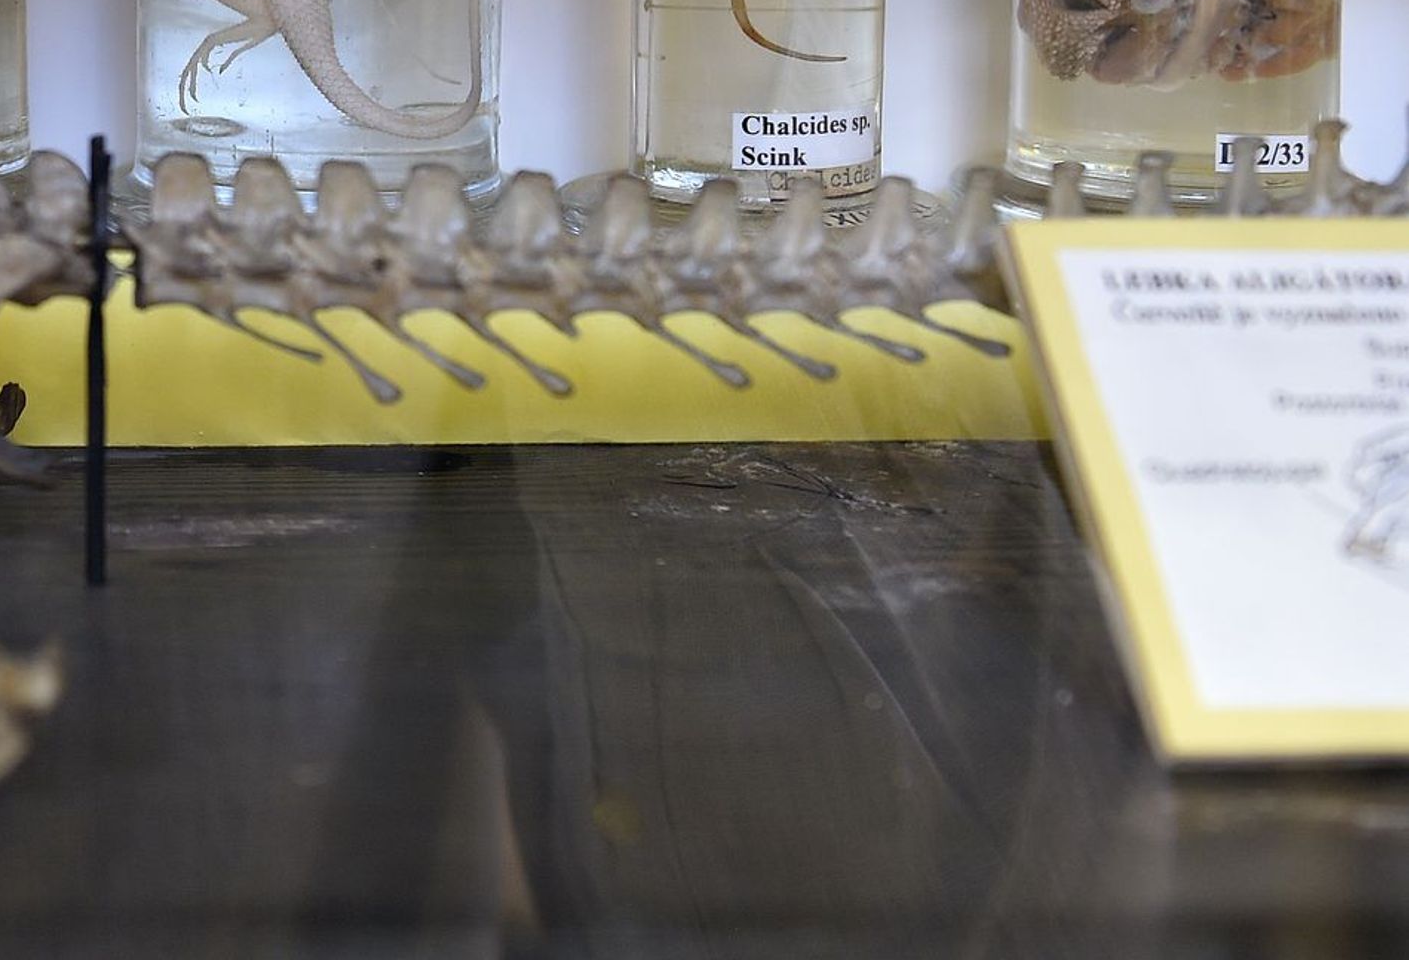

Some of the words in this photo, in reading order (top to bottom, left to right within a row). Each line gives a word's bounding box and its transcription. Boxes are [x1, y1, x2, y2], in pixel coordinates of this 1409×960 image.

[741, 114, 848, 136] Chalcides
[851, 115, 872, 136] sp.
[741, 145, 808, 166] Scink
[1218, 142, 1305, 166] D2/33
[768, 164, 876, 191] Chlcides
